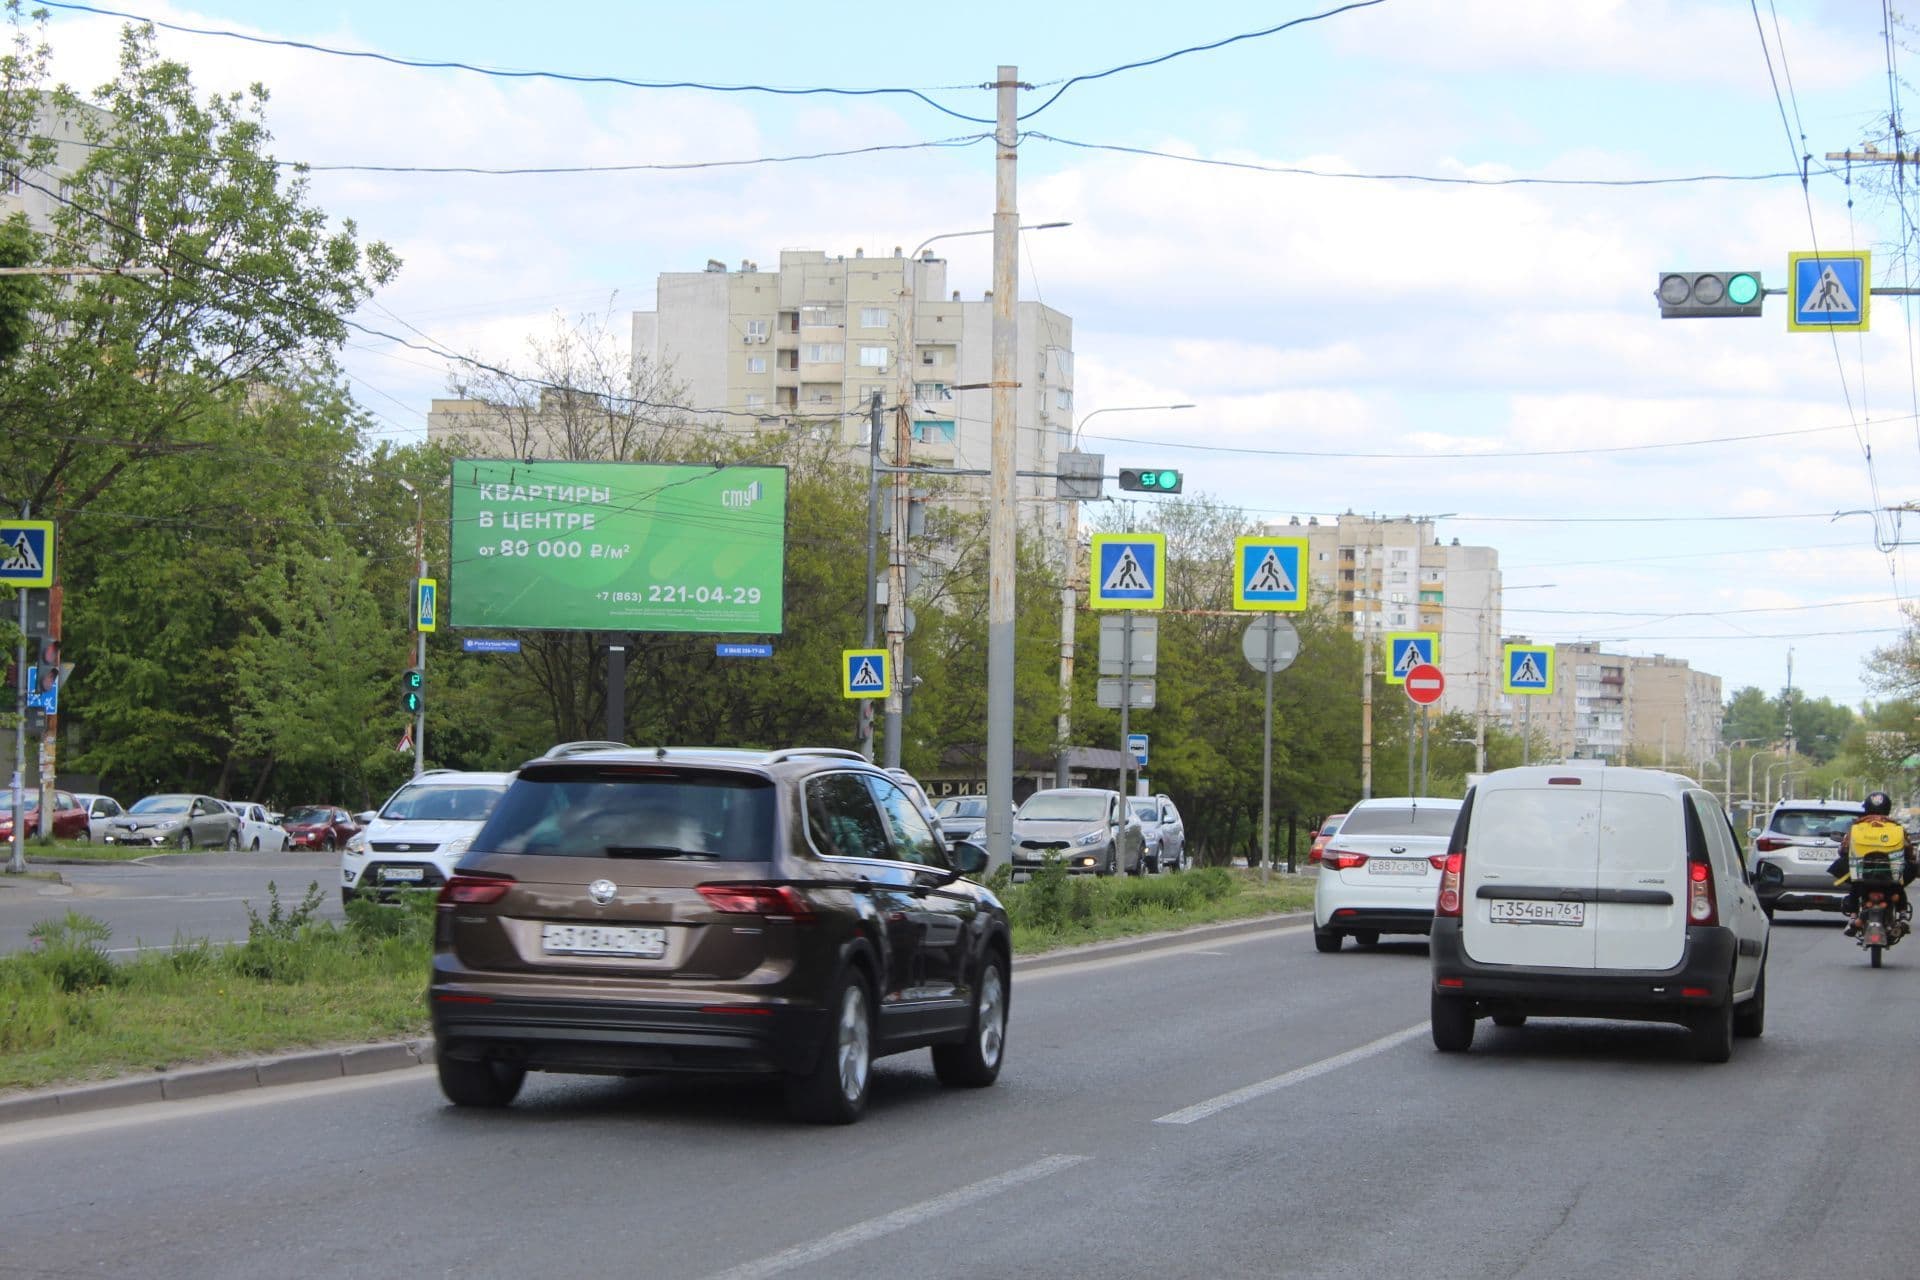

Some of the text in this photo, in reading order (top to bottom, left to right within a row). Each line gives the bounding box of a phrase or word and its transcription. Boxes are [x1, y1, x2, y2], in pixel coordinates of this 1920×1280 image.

[1142, 473, 1156, 486] 53
[480, 483, 610, 504] КВАРТИРЫ
[479, 510, 596, 531] В ЦЕНТРЕ
[479, 546, 496, 556] от
[500, 539, 530, 557] 80
[537, 540, 582, 558] 000
[594, 585, 762, 605] +7 (863) 221-04-29
[925, 782, 986, 797] АРИЯ
[1497, 902, 1580, 918] Т354ВН 761
